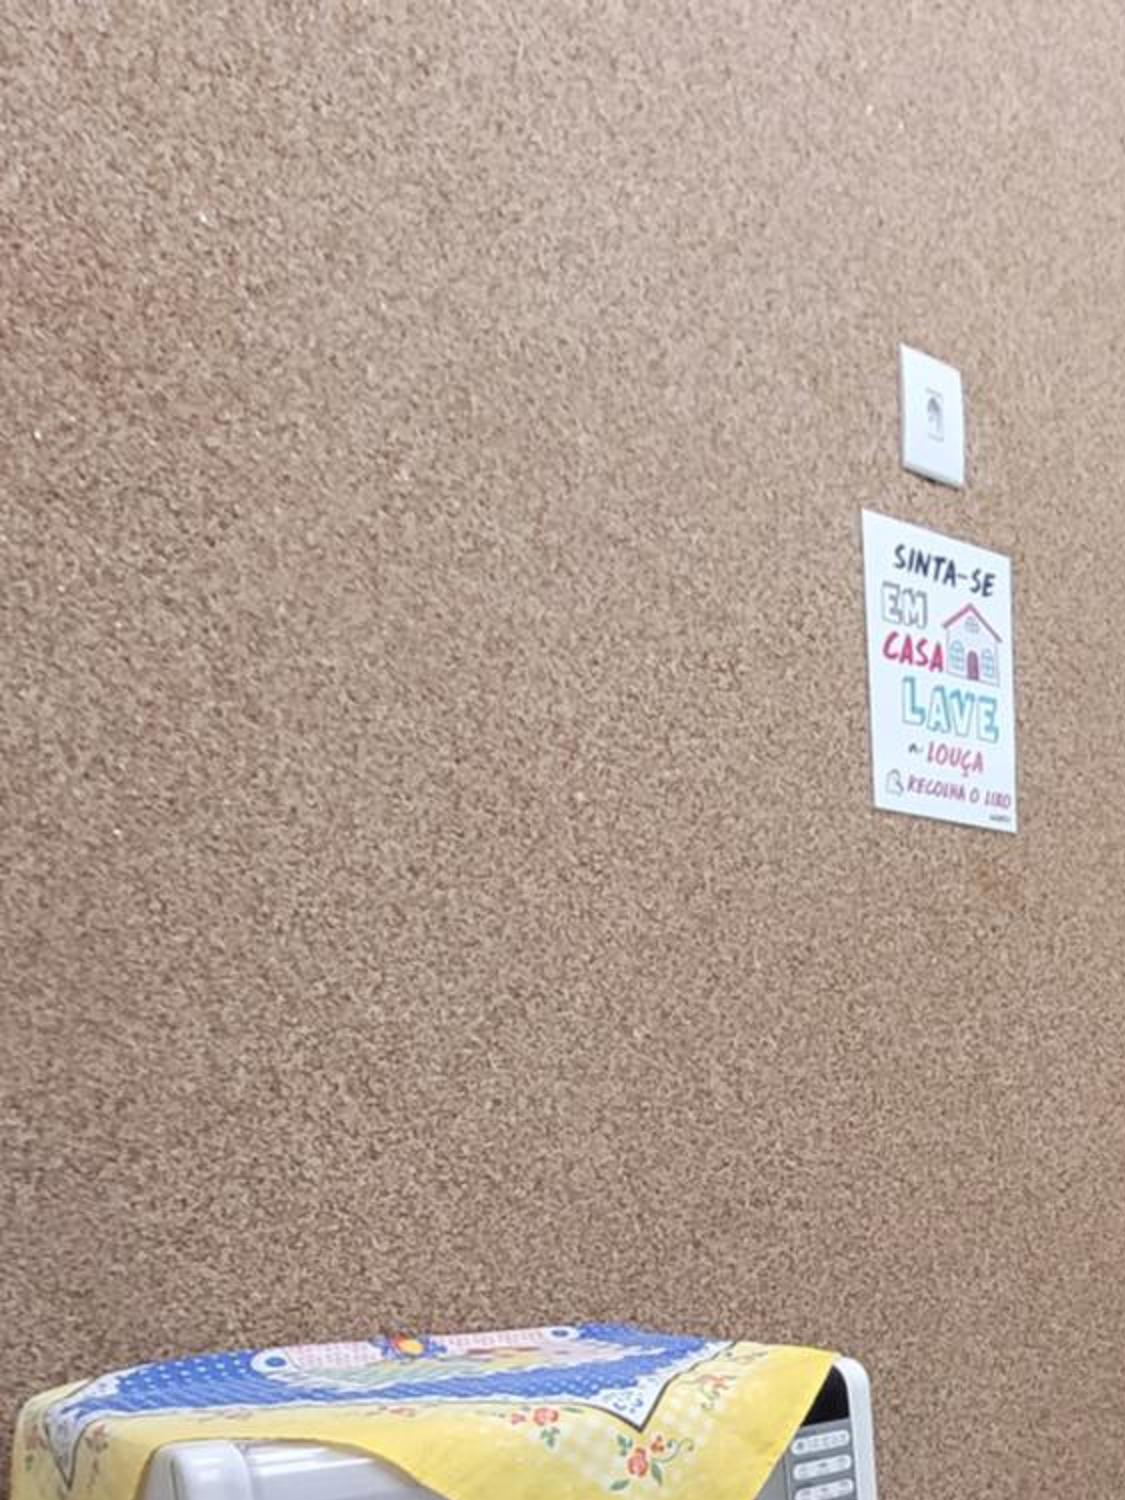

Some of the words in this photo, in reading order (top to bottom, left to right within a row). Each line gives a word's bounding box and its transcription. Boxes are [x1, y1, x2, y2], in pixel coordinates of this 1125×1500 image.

[893, 543, 996, 598] SINTA-SE
[881, 580, 928, 630] EM
[883, 631, 944, 673] CASA
[901, 676, 999, 744] LAVE
[927, 741, 984, 778] LOUÇA
[907, 774, 966, 801] RECOLHA
[969, 786, 980, 803] O
